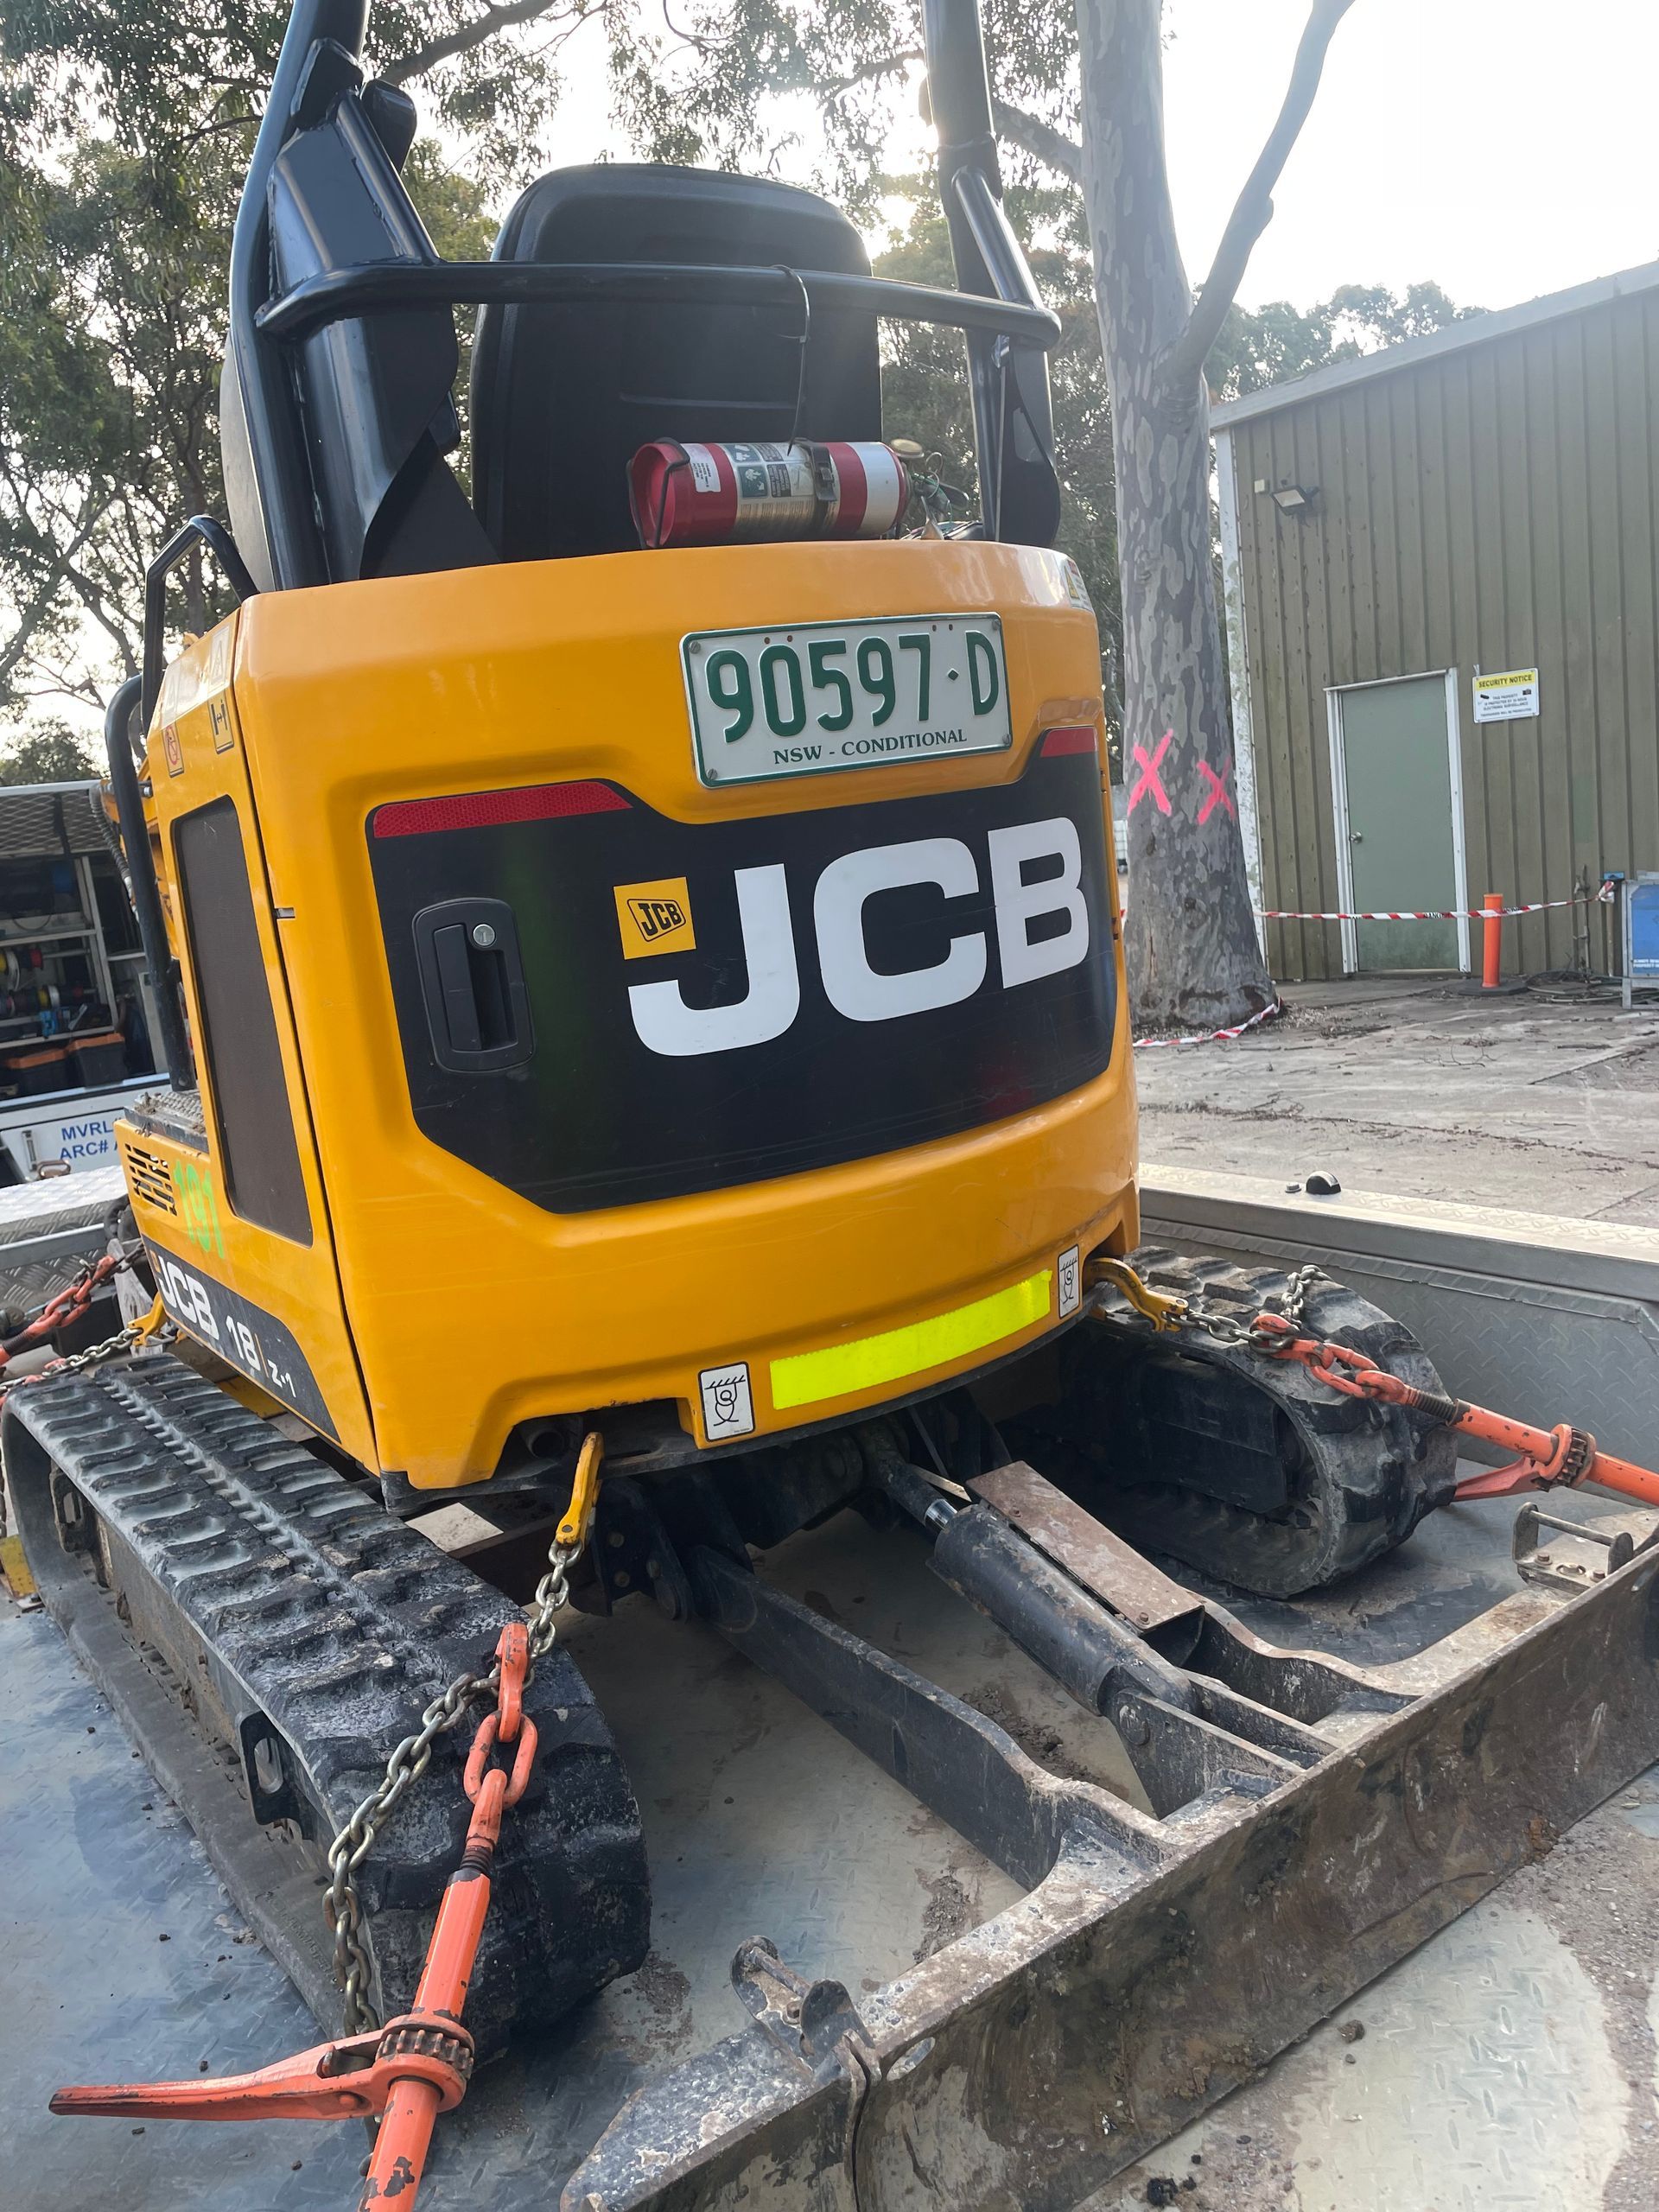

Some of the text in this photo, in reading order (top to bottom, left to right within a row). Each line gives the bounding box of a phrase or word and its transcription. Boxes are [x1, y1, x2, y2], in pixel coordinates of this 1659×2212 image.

[1478, 674, 1533, 688] SECURITY NOTICE
[772, 744, 823, 765] NSW
[841, 728, 967, 756] CONDITIONAL
[628, 817, 1089, 1057] JCB
[638, 903, 682, 936] JCB
[61, 1117, 120, 1141] MVRL
[60, 1140, 109, 1160] ARC#
[173, 1159, 225, 1259] 191
[157, 1255, 219, 1340] JCB
[226, 1315, 261, 1371] 18
